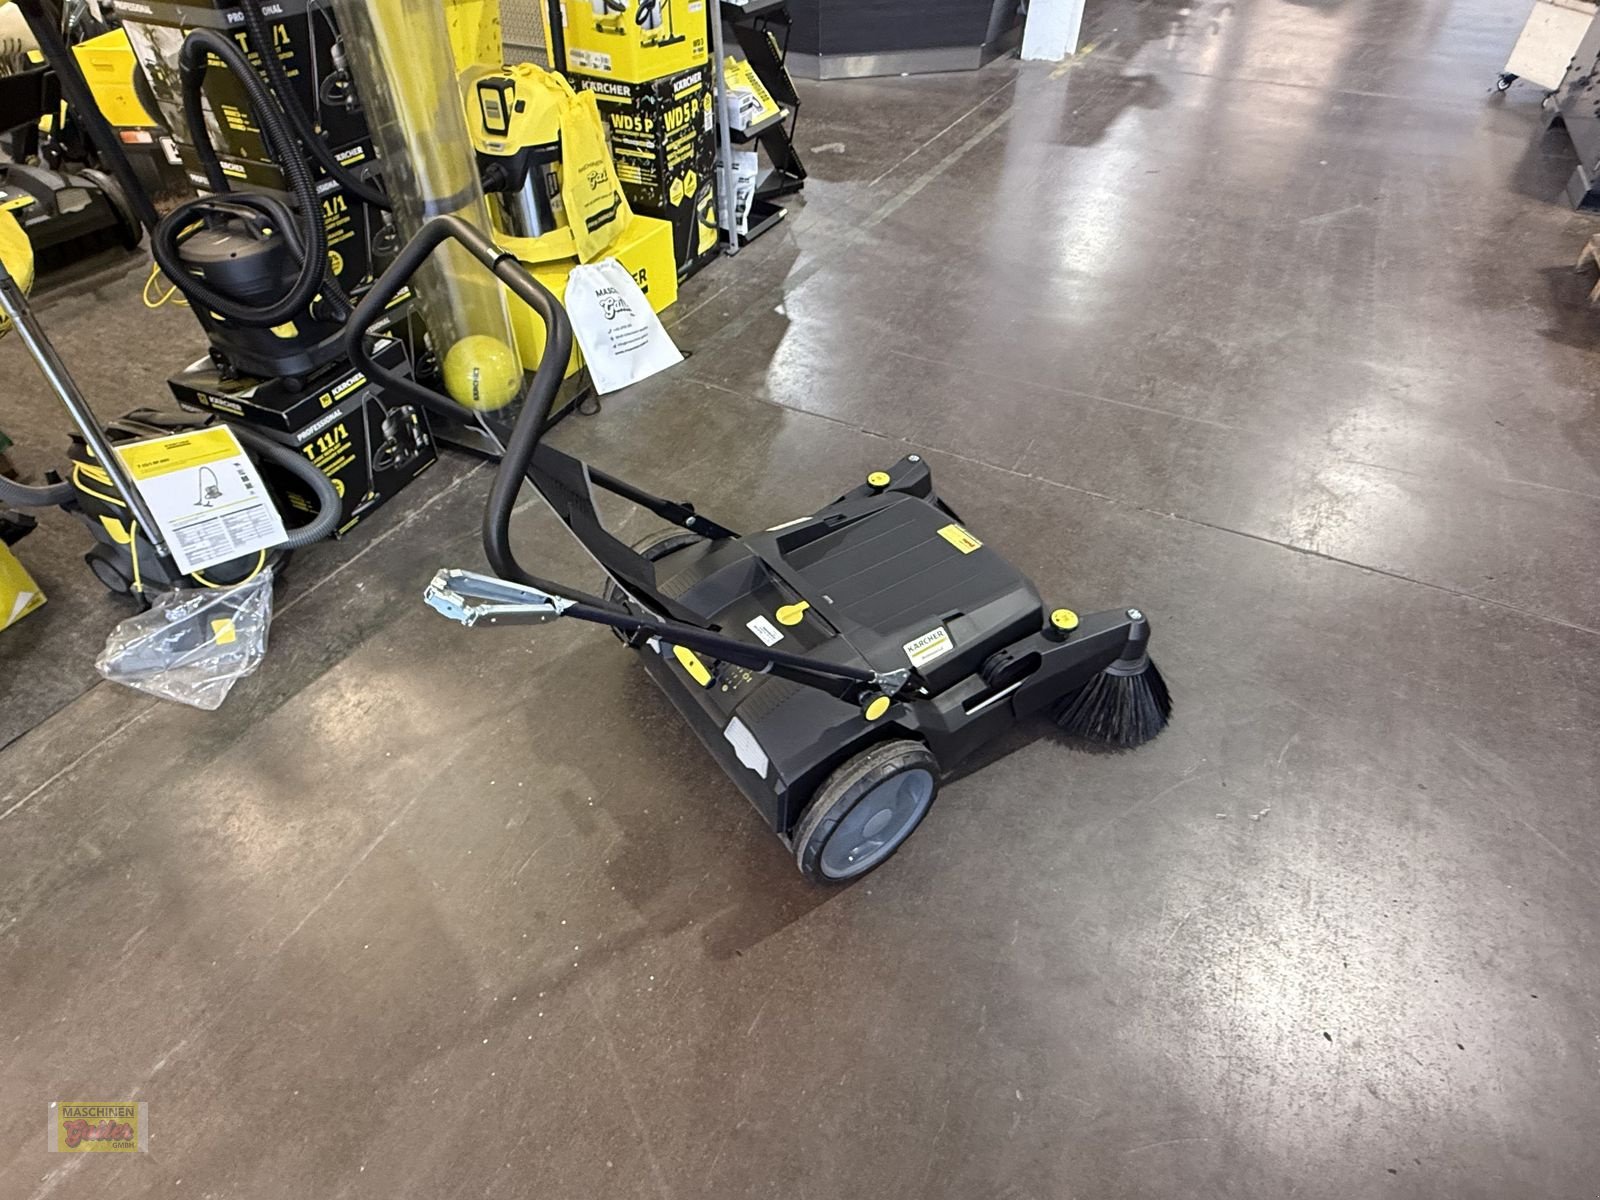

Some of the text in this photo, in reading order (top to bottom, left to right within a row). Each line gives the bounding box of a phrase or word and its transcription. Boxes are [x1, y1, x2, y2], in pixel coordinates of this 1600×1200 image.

[296, 409, 343, 442] PROFESSIONAL
[302, 443, 316, 460] T
[317, 423, 349, 453] 11/1
